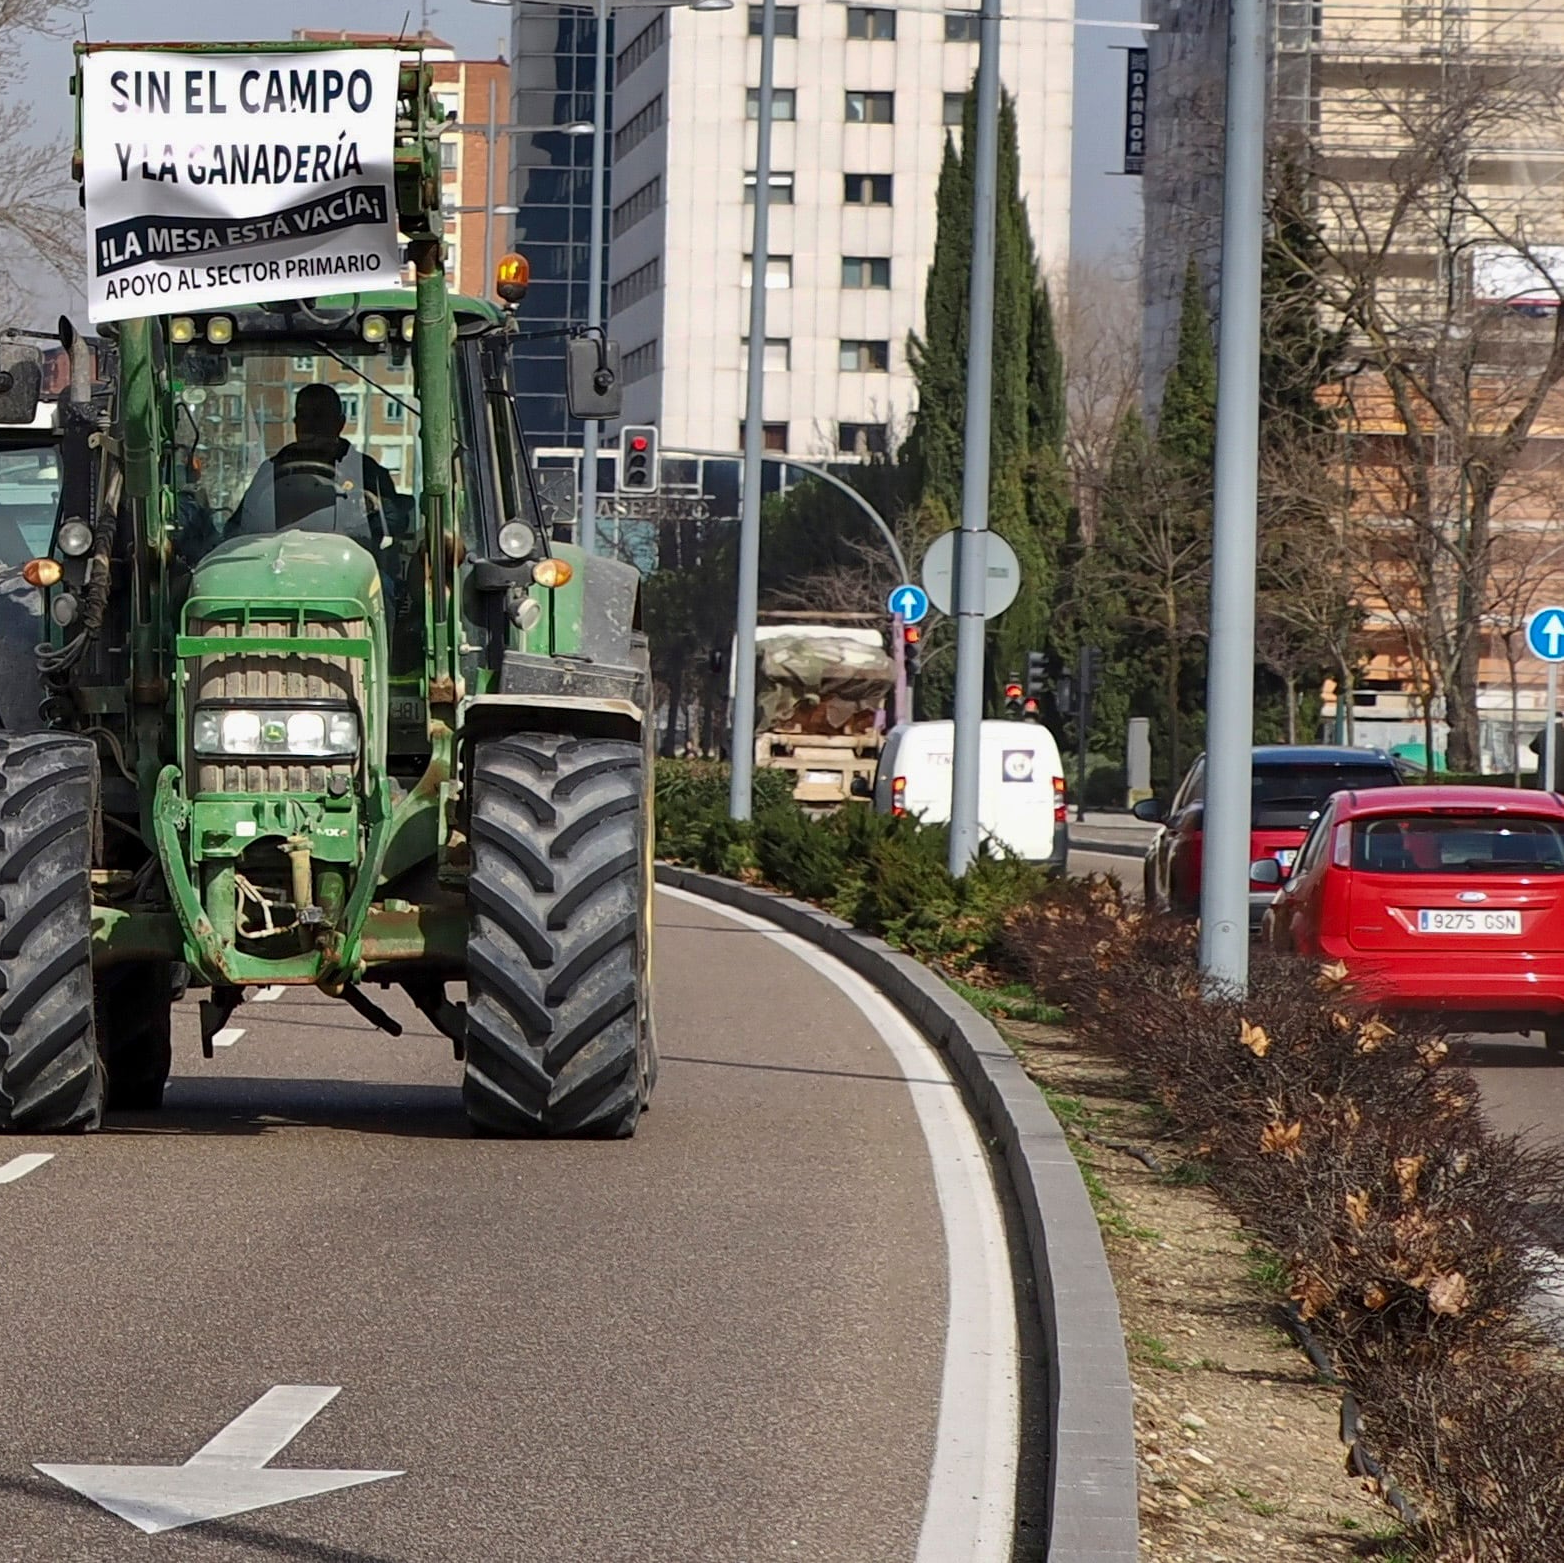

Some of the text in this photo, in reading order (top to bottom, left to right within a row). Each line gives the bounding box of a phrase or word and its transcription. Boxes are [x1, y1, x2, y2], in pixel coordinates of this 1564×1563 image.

[110, 68, 373, 115] SIN EL CAMPO
[114, 130, 364, 186] Y LA GANADERÍA
[147, 226, 222, 254] MESA
[226, 213, 291, 246] ESTÁ
[105, 253, 381, 301] APOYO AL SECTOR PRIMARIO
[1433, 913, 1516, 930] 9275 GSN
